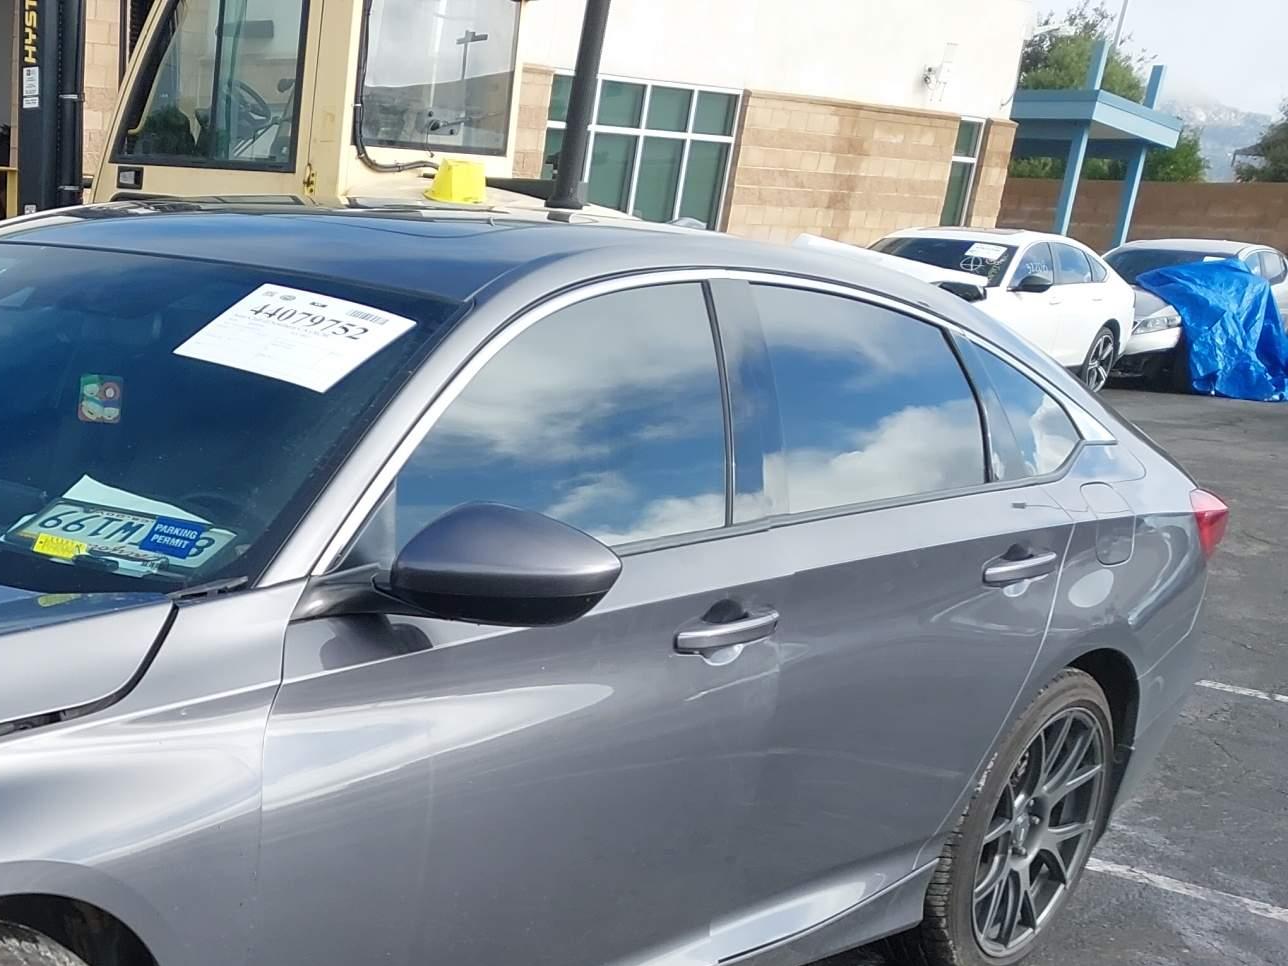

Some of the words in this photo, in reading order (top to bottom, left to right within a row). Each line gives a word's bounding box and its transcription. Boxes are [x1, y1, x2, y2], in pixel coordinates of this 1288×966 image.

[249, 303, 369, 340] 44079752
[154, 523, 198, 540] PARKING
[150, 534, 190, 549] PERMIT
